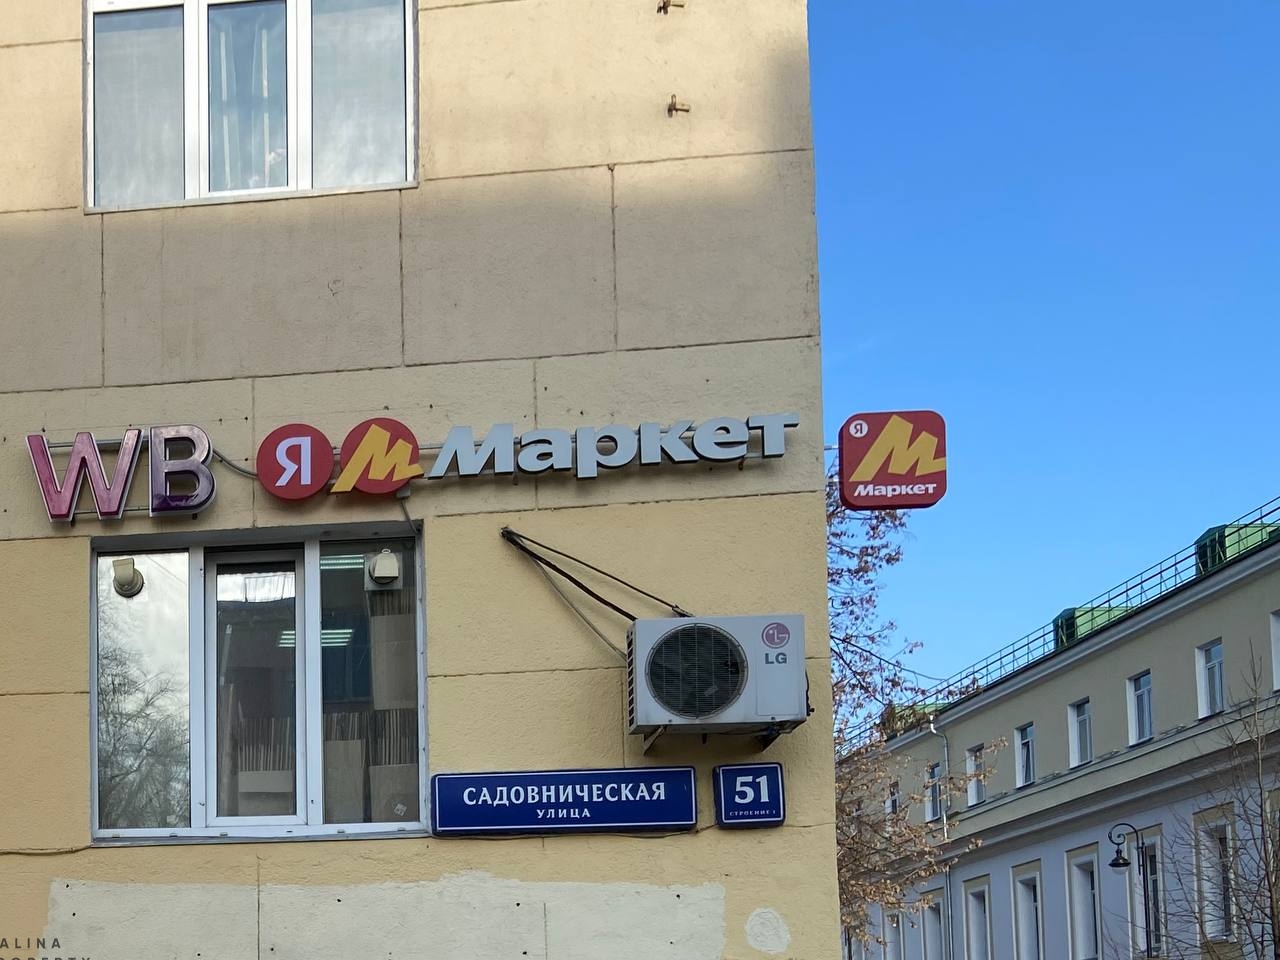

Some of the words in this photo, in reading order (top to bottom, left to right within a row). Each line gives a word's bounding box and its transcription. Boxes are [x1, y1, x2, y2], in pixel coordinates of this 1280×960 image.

[275, 436, 312, 486] Я
[427, 413, 800, 479] Маркет
[26, 424, 216, 522] WB
[853, 484, 937, 498] Маркет
[765, 652, 787, 664] LG
[463, 782, 666, 806] САДОВНИЧЕСКАЯ
[734, 776, 770, 804] 51
[537, 808, 591, 819] УЛИЦА
